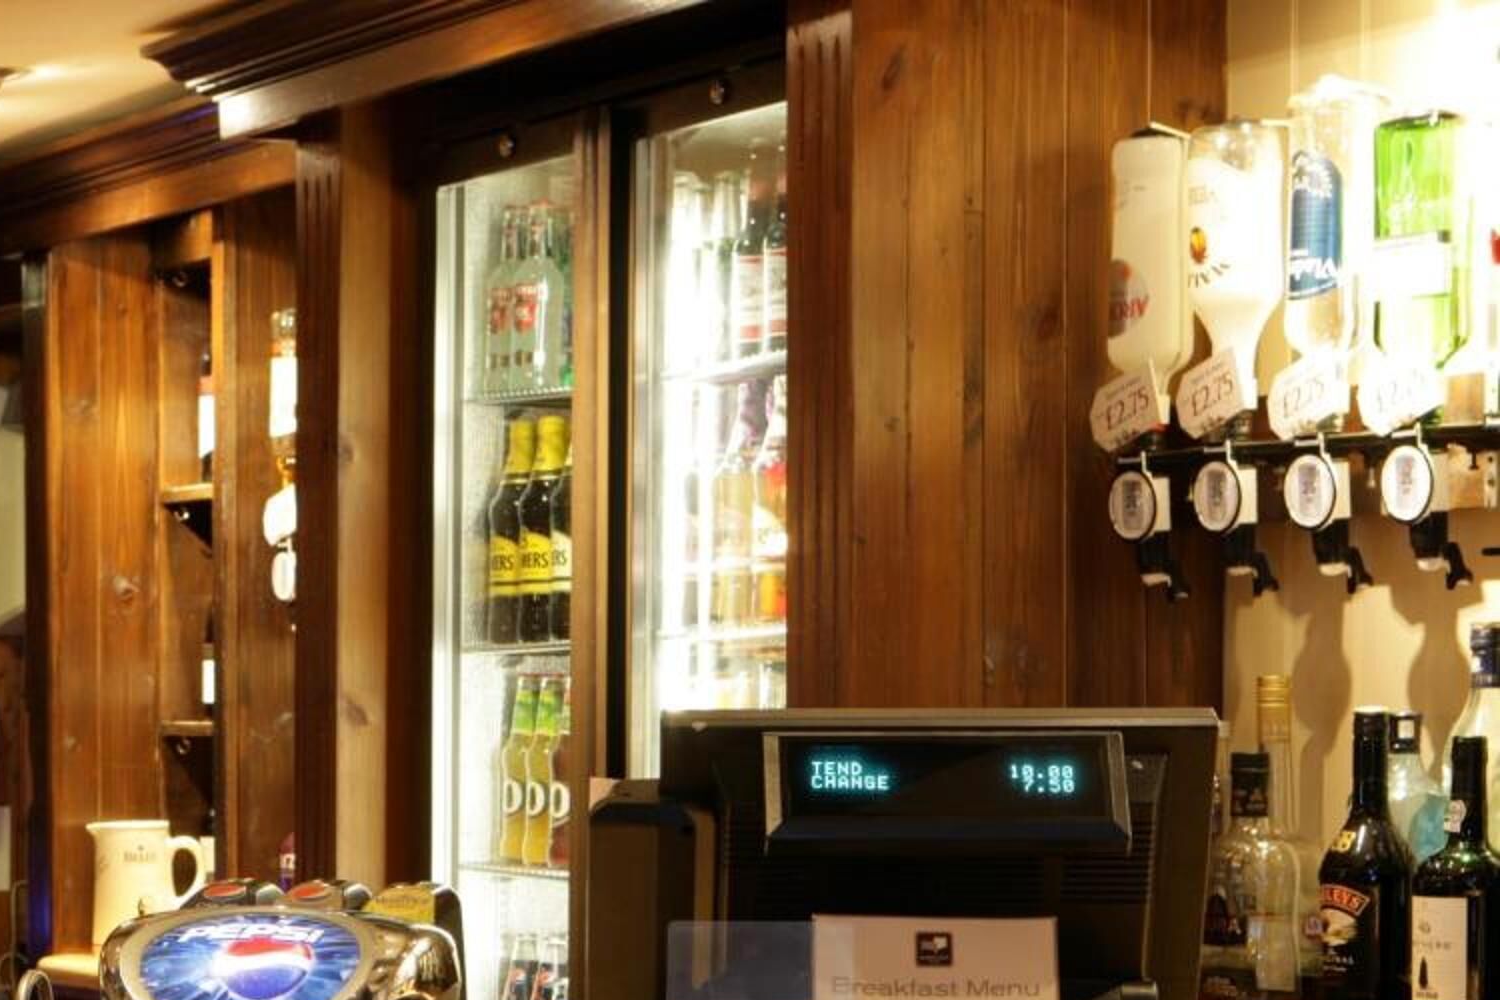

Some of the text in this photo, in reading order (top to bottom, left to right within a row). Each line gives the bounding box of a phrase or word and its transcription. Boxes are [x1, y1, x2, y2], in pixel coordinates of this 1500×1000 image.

[1192, 371, 1234, 417] £2.75
[1105, 386, 1149, 431] £2.75
[811, 761, 863, 776] TEND
[1010, 764, 1074, 780] 10.00
[811, 775, 889, 790] CHANGE
[1023, 779, 1075, 794] 7.50
[177, 922, 326, 943] PEPSI
[832, 976, 1041, 998] Breakfast Menu
